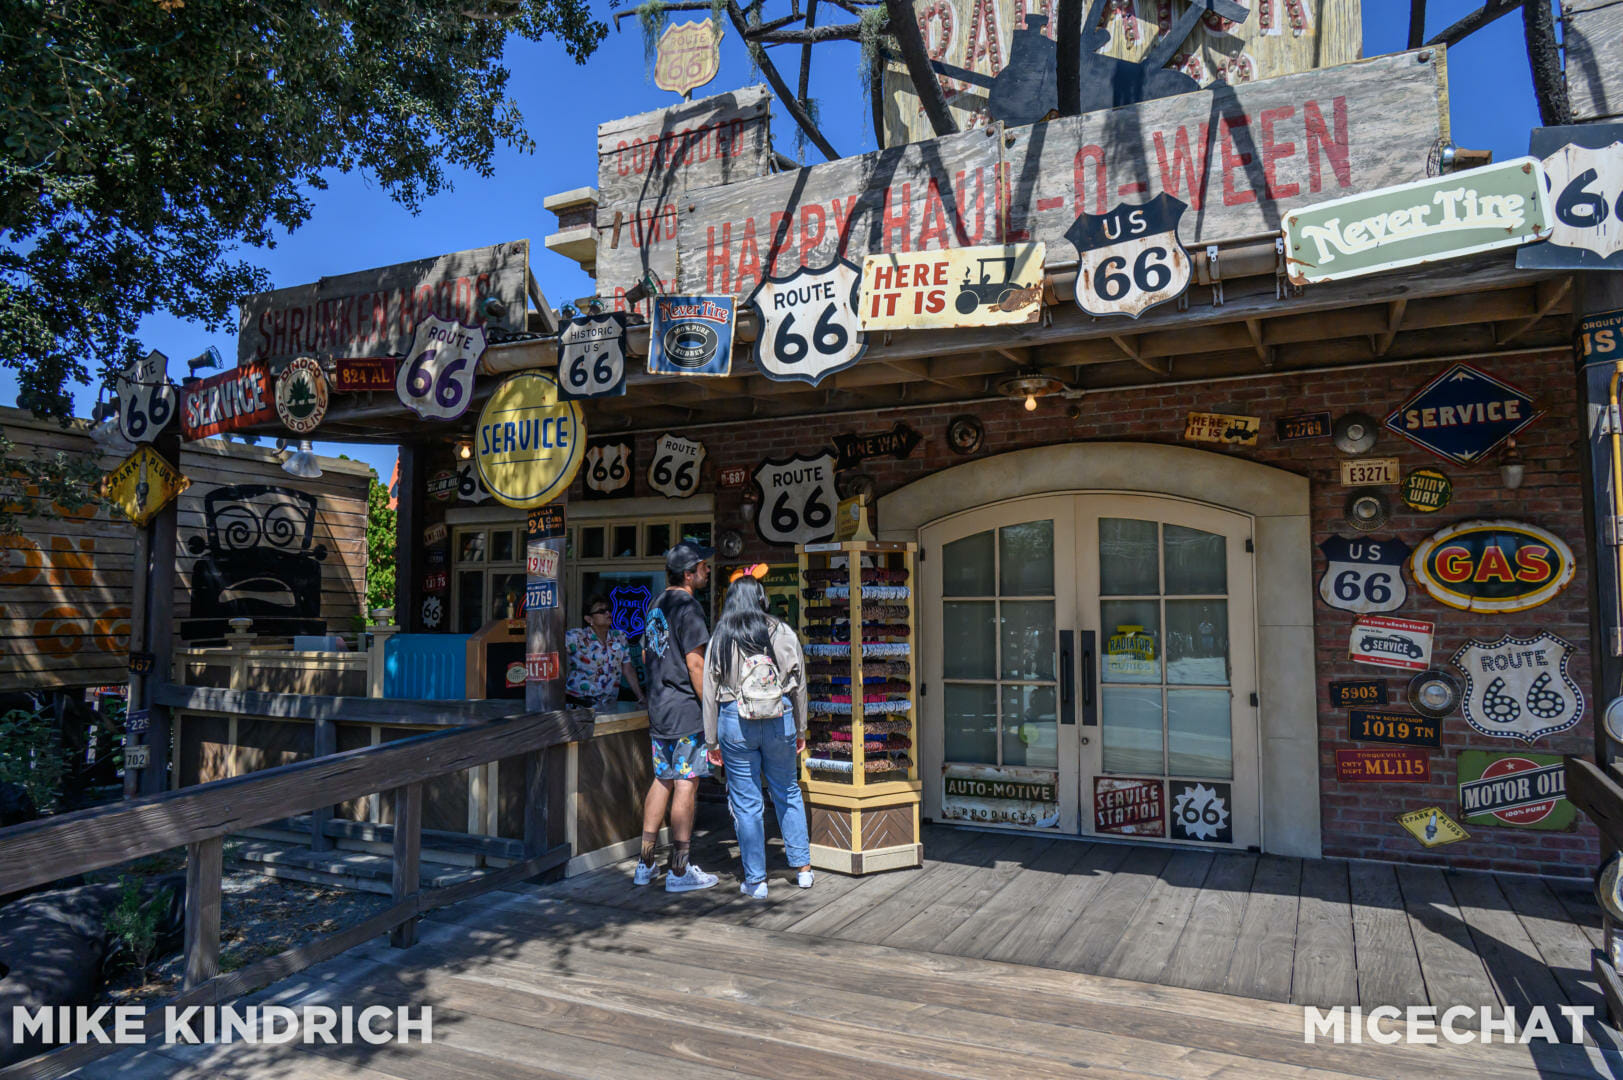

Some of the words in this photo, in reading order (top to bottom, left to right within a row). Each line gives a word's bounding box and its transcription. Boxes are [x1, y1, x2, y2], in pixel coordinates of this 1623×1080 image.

[669, 32, 709, 48] ROUTE
[667, 59, 702, 81] 66
[616, 118, 744, 176] CORRODED
[1555, 167, 1623, 229] 6
[1101, 208, 1147, 241] US
[1301, 201, 1431, 265] Never
[1432, 186, 1526, 228] Tire
[706, 195, 857, 294] HAPPY
[873, 261, 950, 291] HERE
[1094, 246, 1172, 302] 66
[773, 281, 836, 311] ROUTE
[870, 292, 902, 319] IT
[914, 289, 947, 316] IS
[257, 290, 389, 357] SHRUNKEN
[400, 273, 491, 337] HOODS
[659, 301, 700, 322] Never
[702, 300, 729, 321] Tire
[427, 326, 474, 350] ROUTE
[570, 325, 614, 340] HISTORIC
[773, 302, 850, 364] 66
[583, 342, 601, 354] US
[126, 365, 156, 388] ROUTE
[280, 358, 322, 383] DINOCO
[342, 368, 367, 384] 824
[371, 368, 390, 383] AL
[406, 349, 468, 408] 66
[569, 351, 614, 387] 66
[126, 387, 170, 438] 66
[187, 371, 269, 430] SERVICE
[278, 397, 327, 432] GASOLINE
[1191, 415, 1224, 428] HERE
[1405, 399, 1522, 431] SERVICE
[481, 415, 568, 455] SERVICE
[1190, 427, 1203, 436] IT
[1207, 428, 1221, 438] IS
[664, 439, 697, 456] ROUTE
[107, 460, 141, 494] SPARK
[148, 457, 178, 488] PLUGS
[592, 453, 627, 482] 66
[653, 454, 695, 491] 66
[773, 466, 824, 489] ROUTE
[1350, 466, 1391, 482] E327L
[1408, 476, 1447, 493] SHINY
[771, 485, 832, 534] 66
[1410, 489, 1440, 507] WAX
[1349, 542, 1382, 562] US
[1434, 545, 1551, 583] GAS
[1334, 570, 1392, 605] 66
[423, 603, 440, 621] 66
[616, 608, 645, 632] 66
[1110, 638, 1151, 651] RADIATOR
[1372, 639, 1409, 654] SERVICE
[1481, 650, 1549, 672] ROUTE
[1341, 686, 1379, 700] 5903
[1482, 672, 1565, 723] 66
[1362, 719, 1410, 739] 1019
[1413, 726, 1435, 739] TN
[948, 779, 1050, 800] AUTO-MOTIVE
[1098, 783, 1159, 811] SERVICE
[1464, 777, 1531, 810] MOTOR
[962, 807, 1037, 821] PRODUCTS
[1097, 801, 1160, 826] STATION
[1181, 800, 1221, 825] 66
[1404, 813, 1430, 824] SPARK
[1505, 809, 1524, 818] 100%
[1525, 804, 1547, 815] PURE
[1438, 815, 1462, 837] PLUGS
